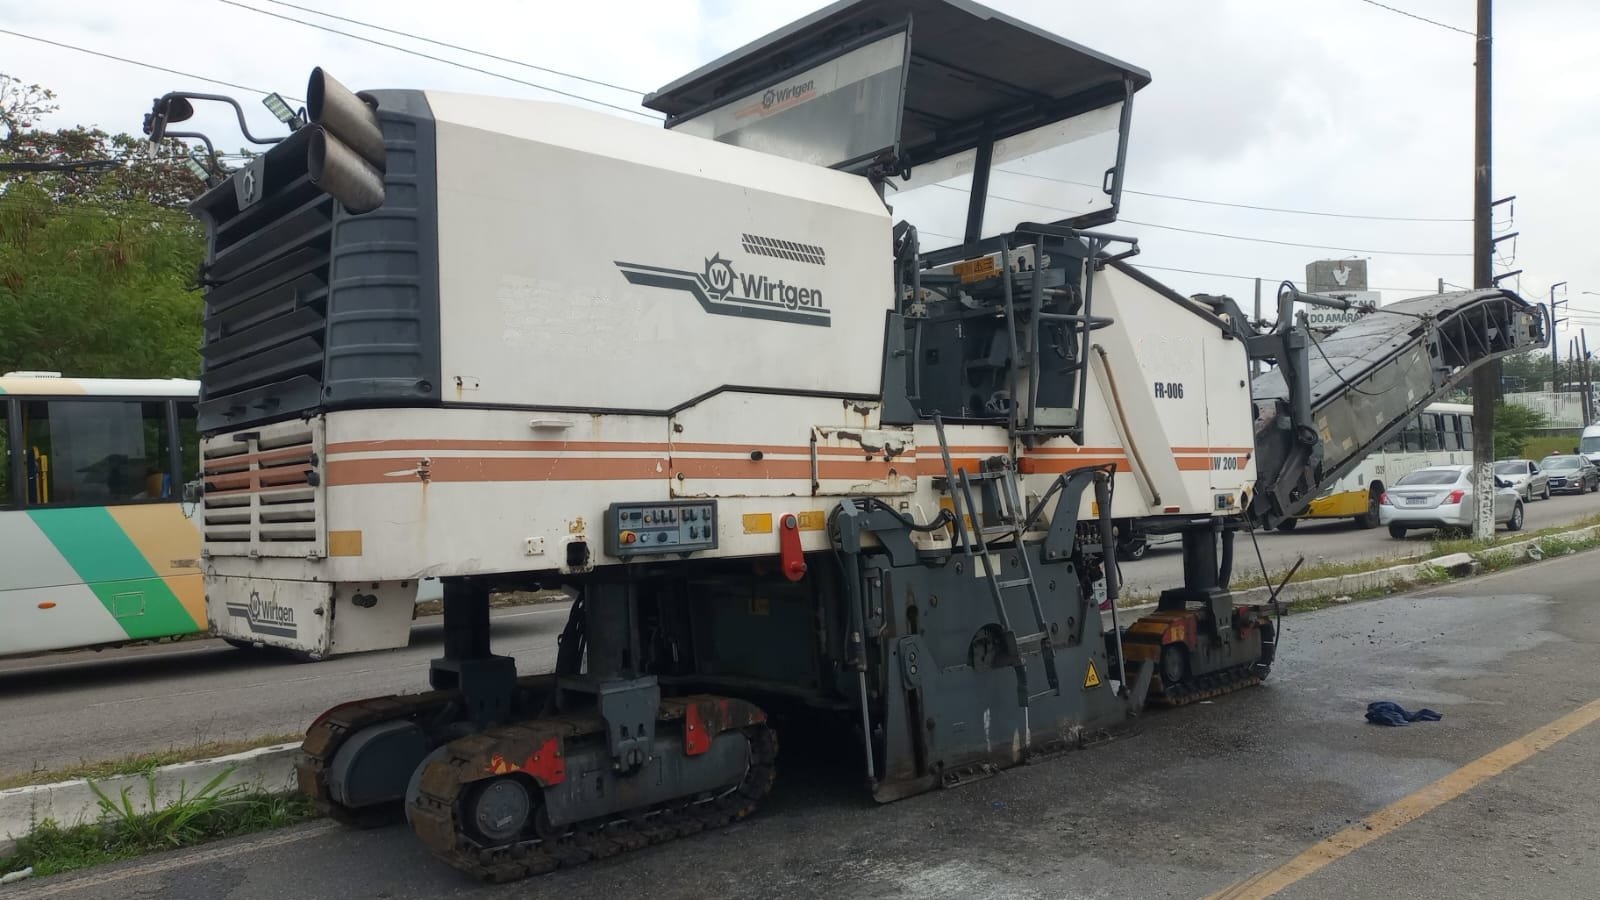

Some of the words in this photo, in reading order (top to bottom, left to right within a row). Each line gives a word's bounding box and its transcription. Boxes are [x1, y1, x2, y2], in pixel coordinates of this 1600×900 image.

[776, 80, 814, 103] Wirtgen
[711, 268, 727, 286] W
[740, 272, 823, 311] Wirtgen
[1310, 313, 1324, 323] DO
[1154, 382, 1184, 399] FR-006
[1213, 456, 1221, 470] W
[1223, 456, 1237, 470] 200
[262, 600, 294, 626] Wirtgen
